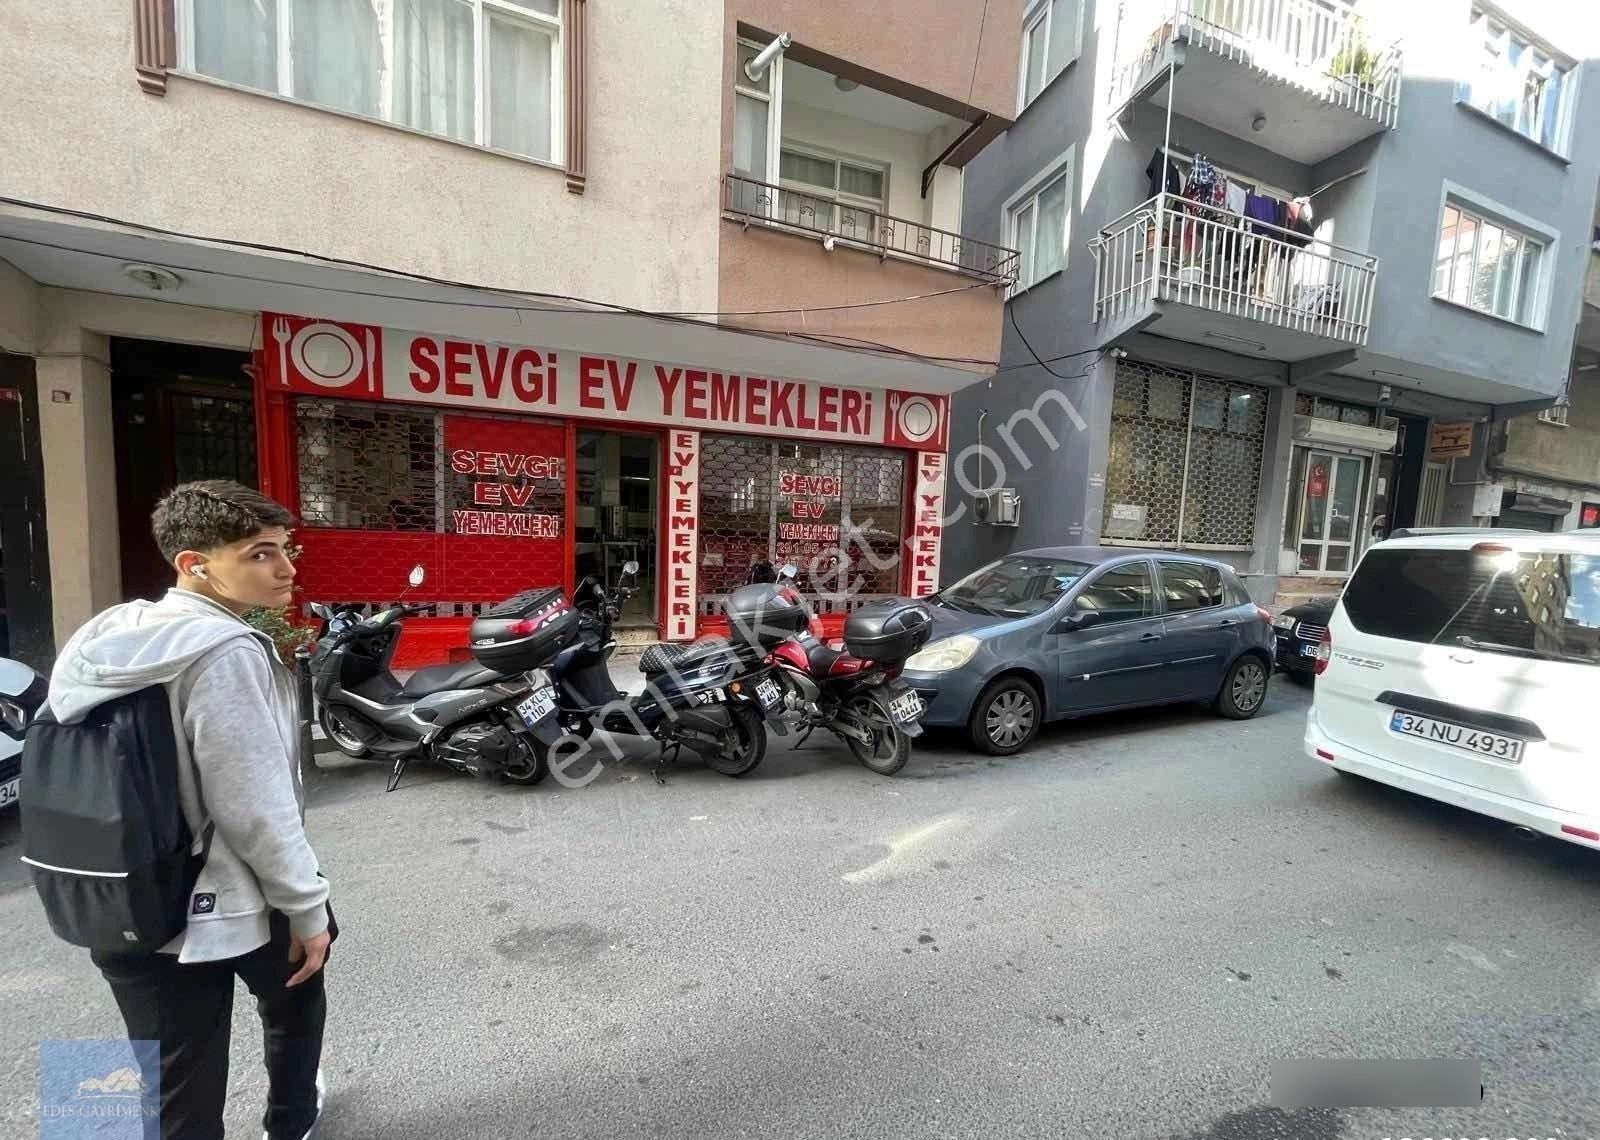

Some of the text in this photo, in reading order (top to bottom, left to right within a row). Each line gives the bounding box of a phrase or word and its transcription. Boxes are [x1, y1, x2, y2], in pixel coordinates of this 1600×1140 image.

[579, 357, 637, 411] EV
[674, 433, 695, 467] EV
[919, 455, 942, 482] EV
[474, 482, 536, 507] EV
[793, 501, 825, 518] EV
[519, 702, 532, 715] 34
[531, 705, 546, 720] 110
[1402, 716, 1519, 759] 34 NU 4931
[0, 783, 17, 804] 34
